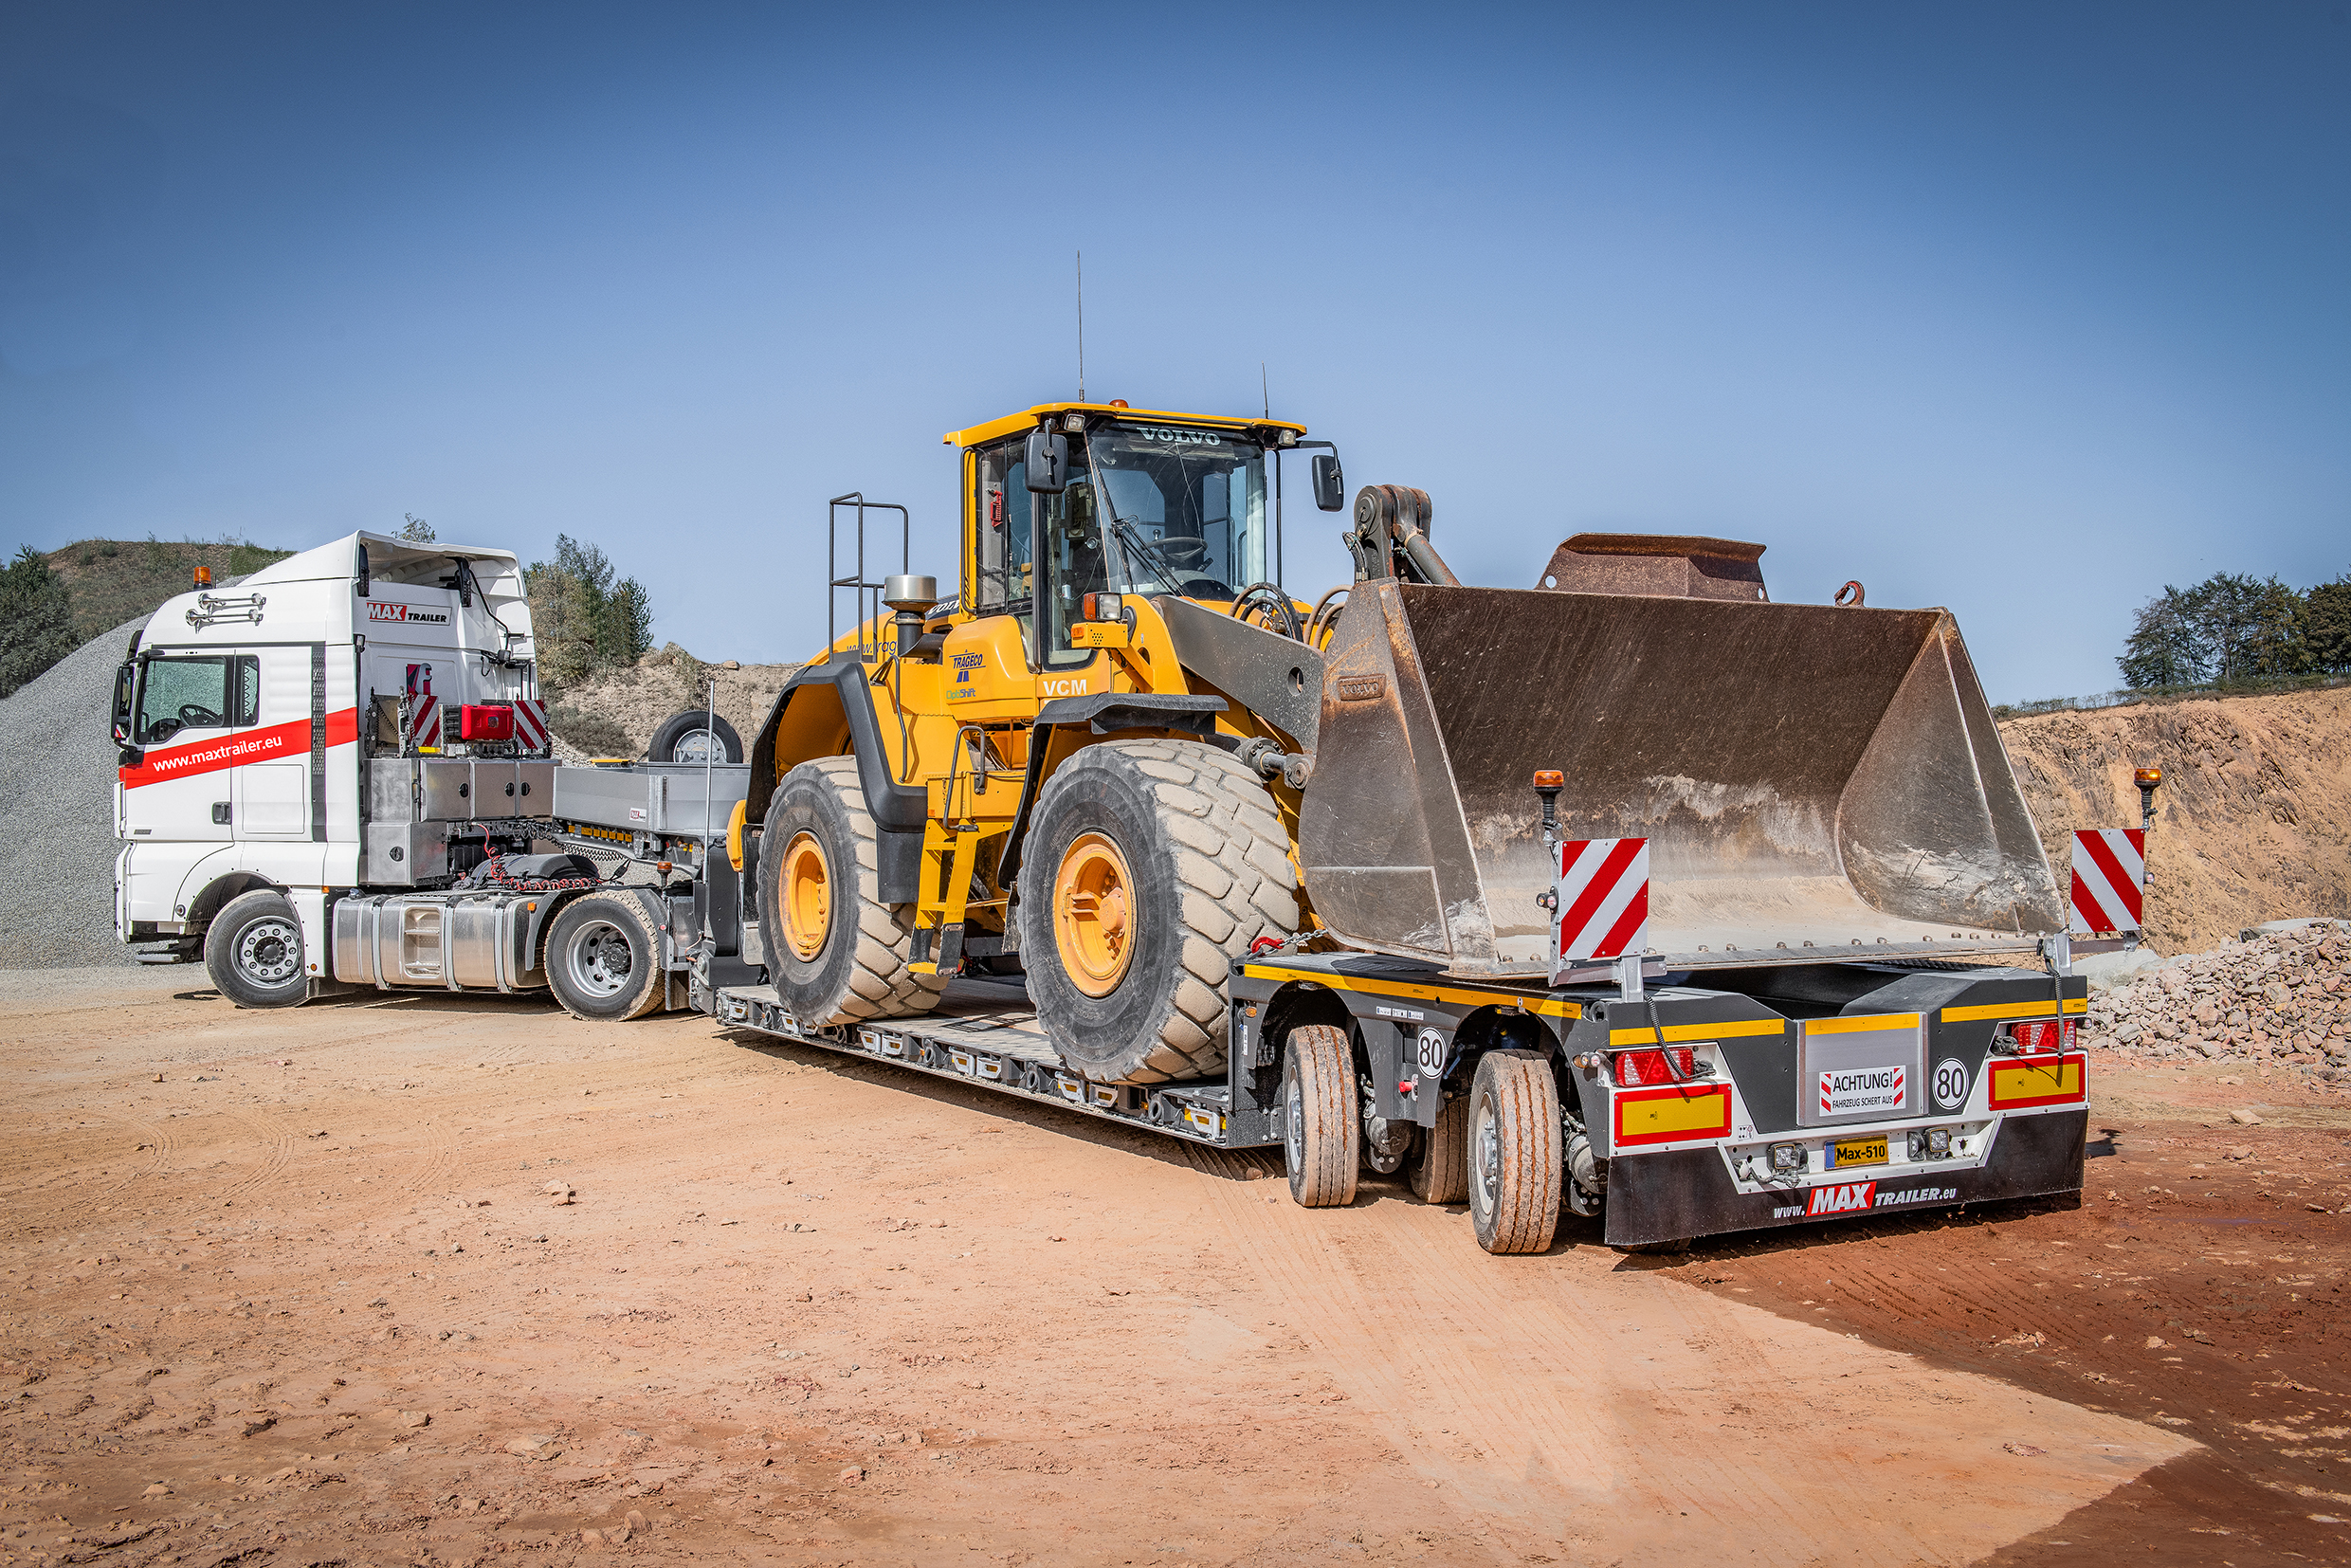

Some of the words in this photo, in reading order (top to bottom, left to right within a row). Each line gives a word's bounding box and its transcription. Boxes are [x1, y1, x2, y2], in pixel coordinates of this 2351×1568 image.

[1136, 427, 1221, 447] VOLVO
[367, 602, 404, 621] MAX
[408, 612, 447, 623] TRAILER
[953, 653, 983, 669] TRAGECO
[1043, 679, 1087, 697] VCM
[1341, 682, 1379, 695] VOLVO
[153, 736, 282, 772] www.maxtrailer.eu
[1419, 1036, 1443, 1069] 80
[1832, 1070, 1893, 1093] ACHTUNG!
[1937, 1067, 1964, 1100] 80
[1832, 1097, 1861, 1109] FAHRZEUG
[1861, 1096, 1881, 1107] SCHERT
[1882, 1095, 1892, 1105] AUS
[1836, 1145, 1886, 1161] Max-510
[1774, 1205, 1806, 1219] www.
[1811, 1183, 1871, 1214] MAX
[1875, 1187, 1958, 1207] TRAILER.eu
